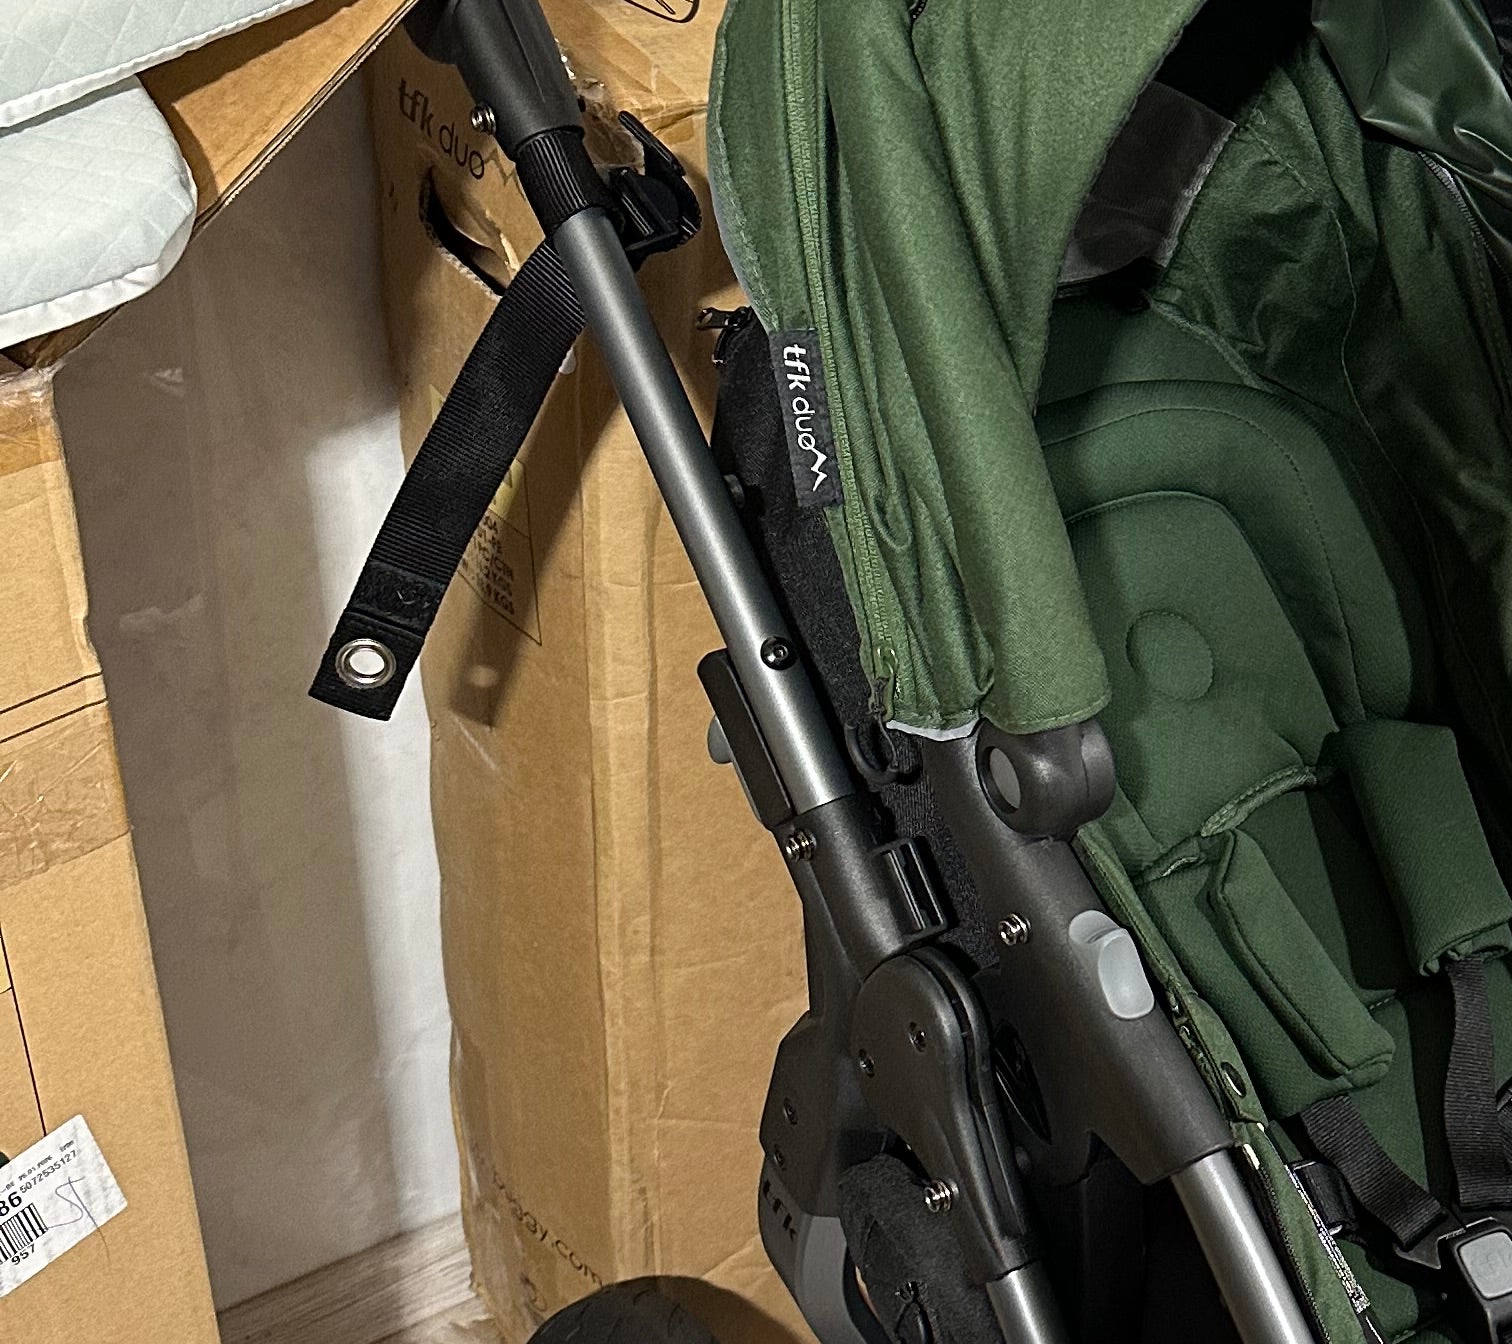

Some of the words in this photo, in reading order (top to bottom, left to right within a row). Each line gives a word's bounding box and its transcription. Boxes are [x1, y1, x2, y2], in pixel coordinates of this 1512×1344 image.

[398, 78, 435, 138] tfk
[440, 122, 485, 180] duo
[783, 344, 811, 391] tfk
[792, 396, 816, 451] duo
